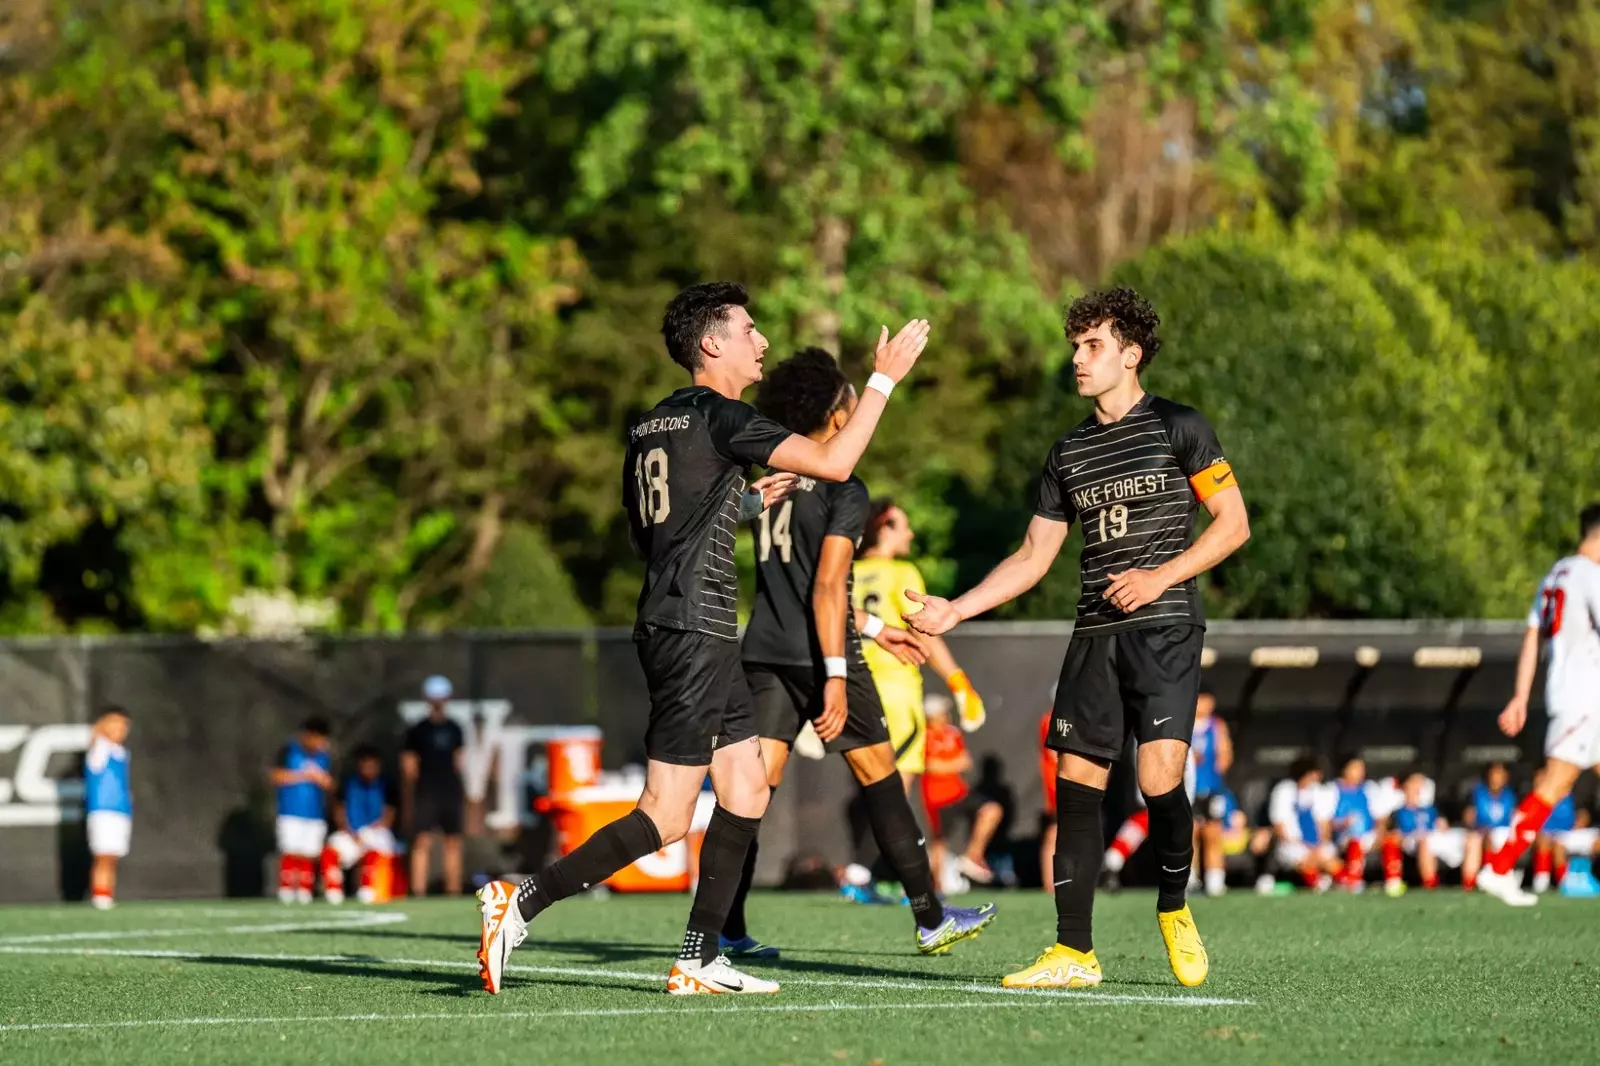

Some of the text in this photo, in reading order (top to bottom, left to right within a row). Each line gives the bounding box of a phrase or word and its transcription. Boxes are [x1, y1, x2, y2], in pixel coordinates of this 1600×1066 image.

[634, 447, 671, 529] 18
[1104, 473, 1168, 502] FOREST
[758, 499, 793, 564] 14
[1099, 504, 1129, 543] 19
